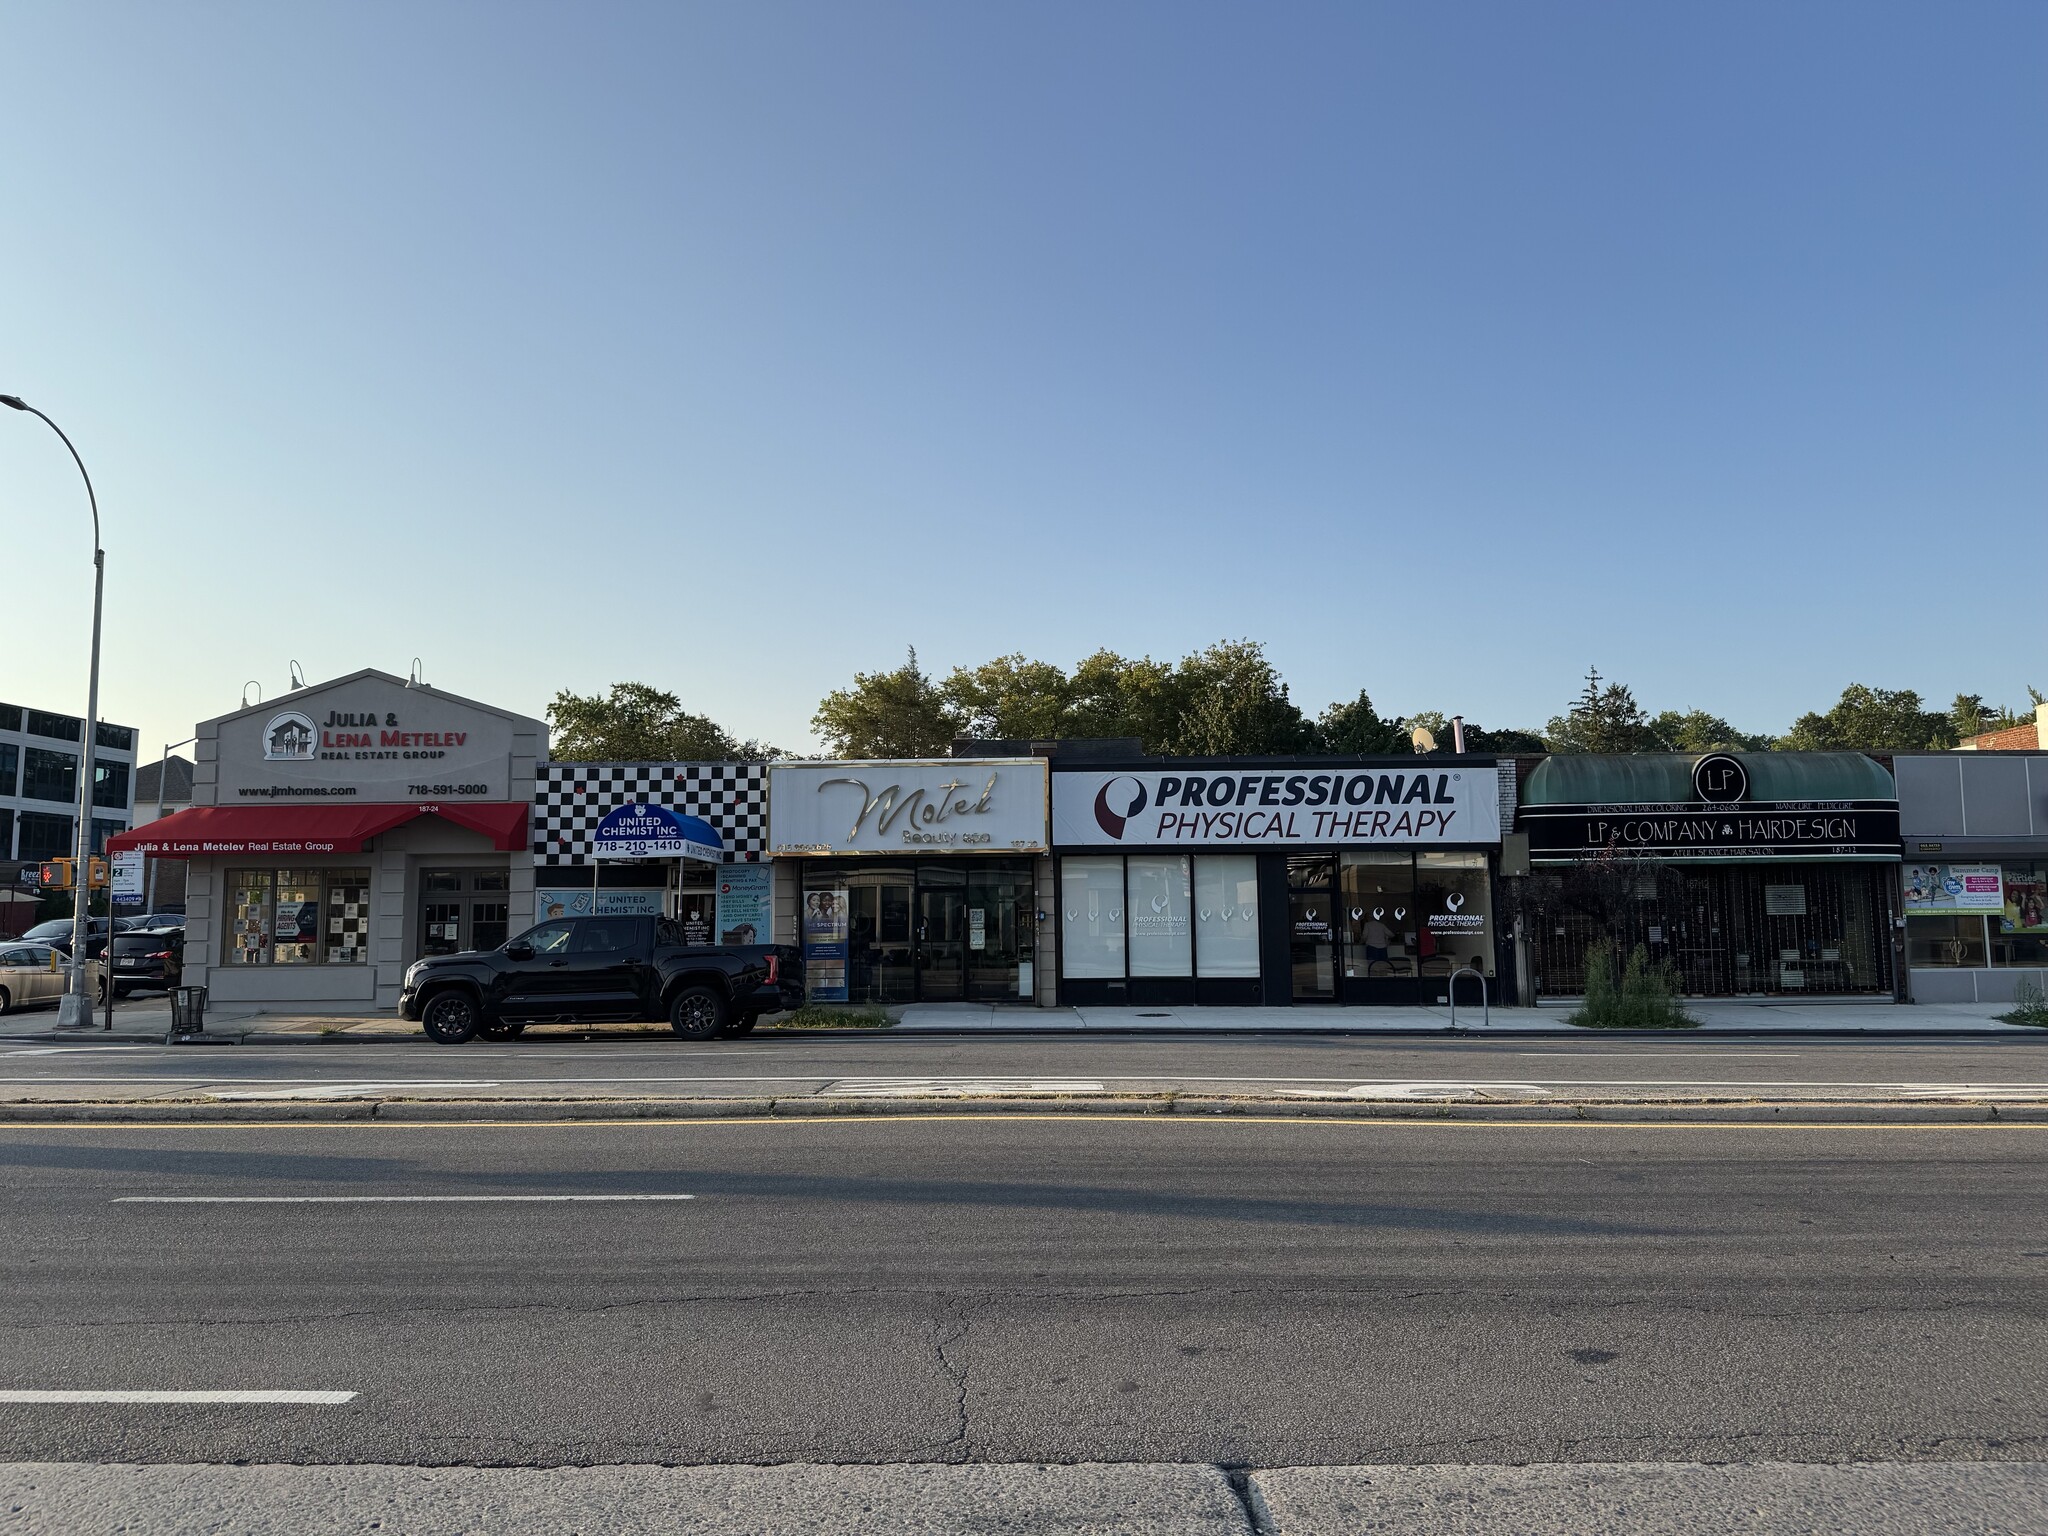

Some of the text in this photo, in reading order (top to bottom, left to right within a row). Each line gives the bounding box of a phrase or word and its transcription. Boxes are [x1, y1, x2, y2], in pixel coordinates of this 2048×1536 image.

[322, 710, 399, 728] JULIA &
[322, 729, 467, 748] LENA METELEV
[321, 750, 446, 761] REAL ESTATE GROUP
[1707, 769, 1735, 791] LP
[238, 785, 357, 798] www.jlmhomes.com
[407, 784, 488, 796] 718-591-5000
[1154, 774, 1455, 807] PROFESSIONAL
[1587, 804, 1688, 814] DIMENSIONAL HAIR COLORING
[1702, 803, 1740, 812] 264-0600
[1775, 801, 1854, 811] MANICURE PEDICURE
[618, 817, 662, 827] UNITED
[1156, 809, 1456, 839] PHYSICAL THERAPY
[601, 826, 678, 836] CHEMIST INC
[1587, 821, 1608, 843] LP
[1611, 826, 1621, 841] &
[1623, 820, 1718, 842] COMPANY
[902, 830, 957, 846] Beauty
[134, 841, 334, 852] Julia & Lena Metelev Real Estate Group
[597, 841, 682, 852] 718-210-1410
[1831, 846, 1857, 855] 187-12
[1697, 848, 1729, 857] SERVICE
[1730, 848, 1748, 856] HAIR
[1748, 847, 1775, 856] SALON
[115, 868, 121, 876] 2
[1981, 867, 1999, 875] Camp
[732, 884, 768, 892] MoneyGram
[609, 896, 646, 904] UNITED
[589, 905, 655, 914] CHEMIST INC
[277, 922, 296, 930] AGENTS
